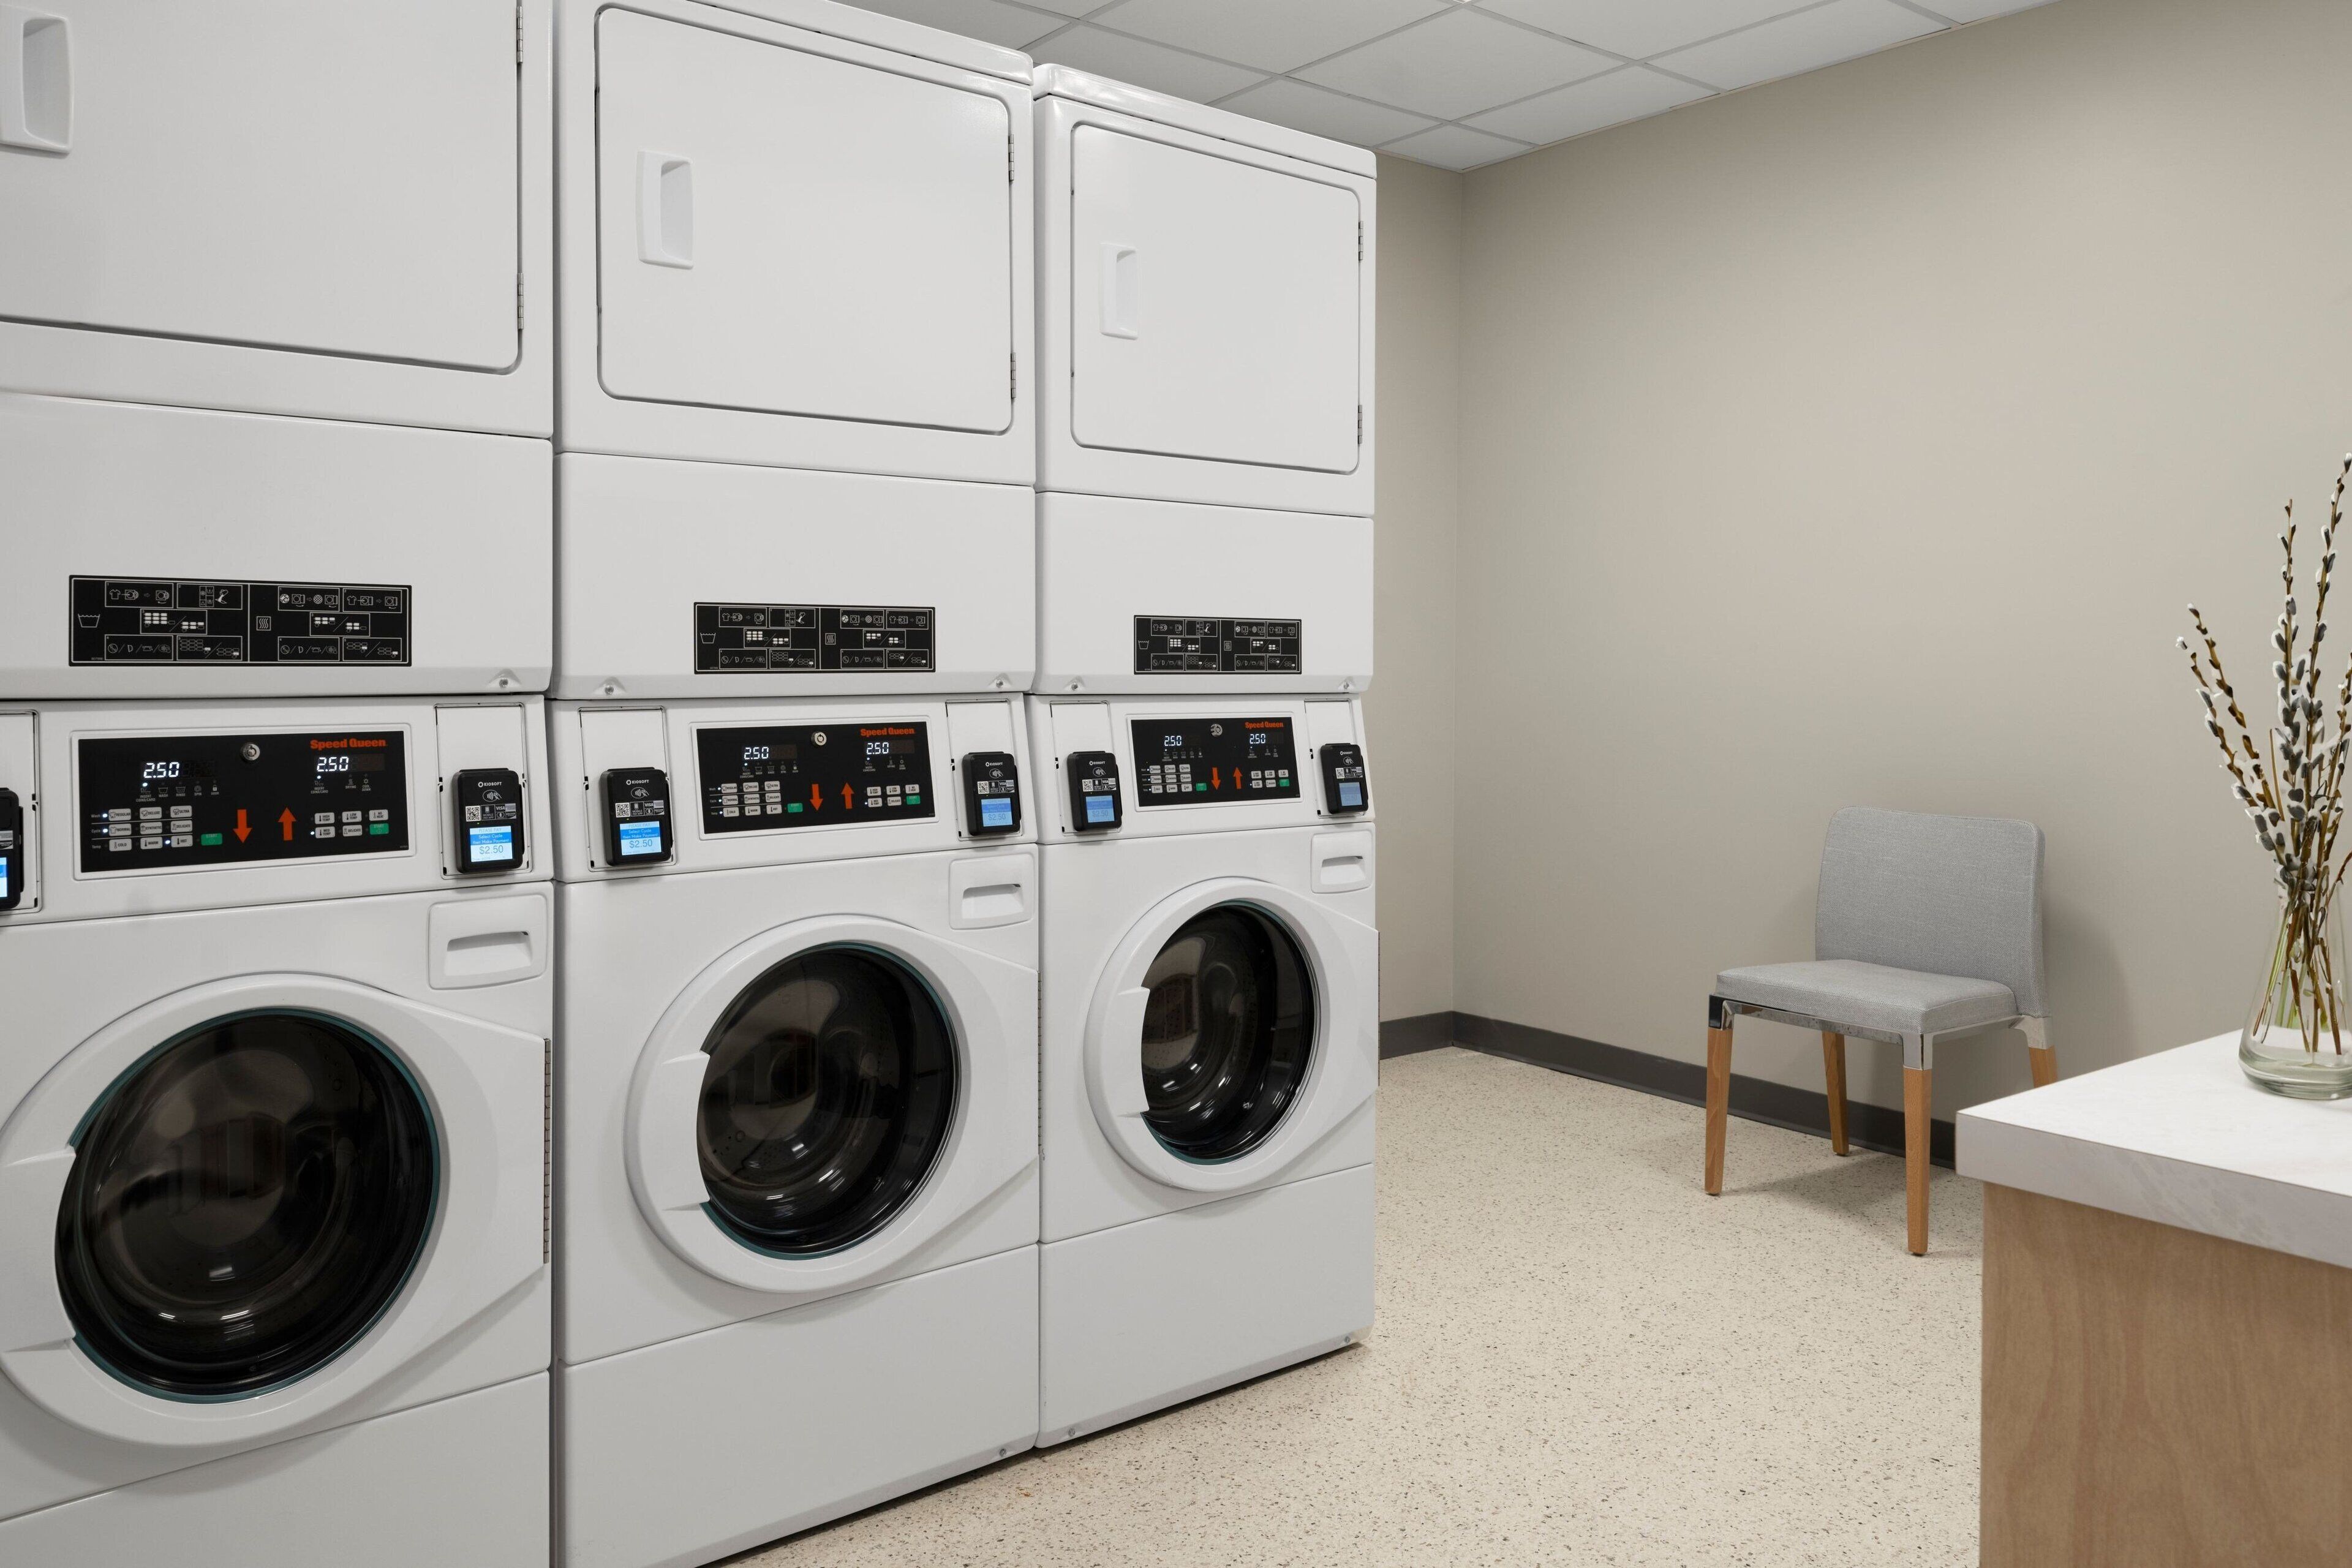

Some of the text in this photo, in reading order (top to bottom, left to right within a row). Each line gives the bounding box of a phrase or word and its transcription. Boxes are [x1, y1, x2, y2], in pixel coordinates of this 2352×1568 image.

[861, 728, 887, 737] Speed
[311, 738, 386, 750] Speed Queen
[1164, 736, 1182, 746] 2.50
[1250, 734, 1265, 744] 2.50
[744, 747, 769, 760] 2.50
[867, 742, 889, 755] 2.50
[316, 756, 349, 772] 2.50
[143, 762, 179, 778] 2.50
[630, 839, 652, 848] $2.50
[480, 845, 503, 854] $2.50
